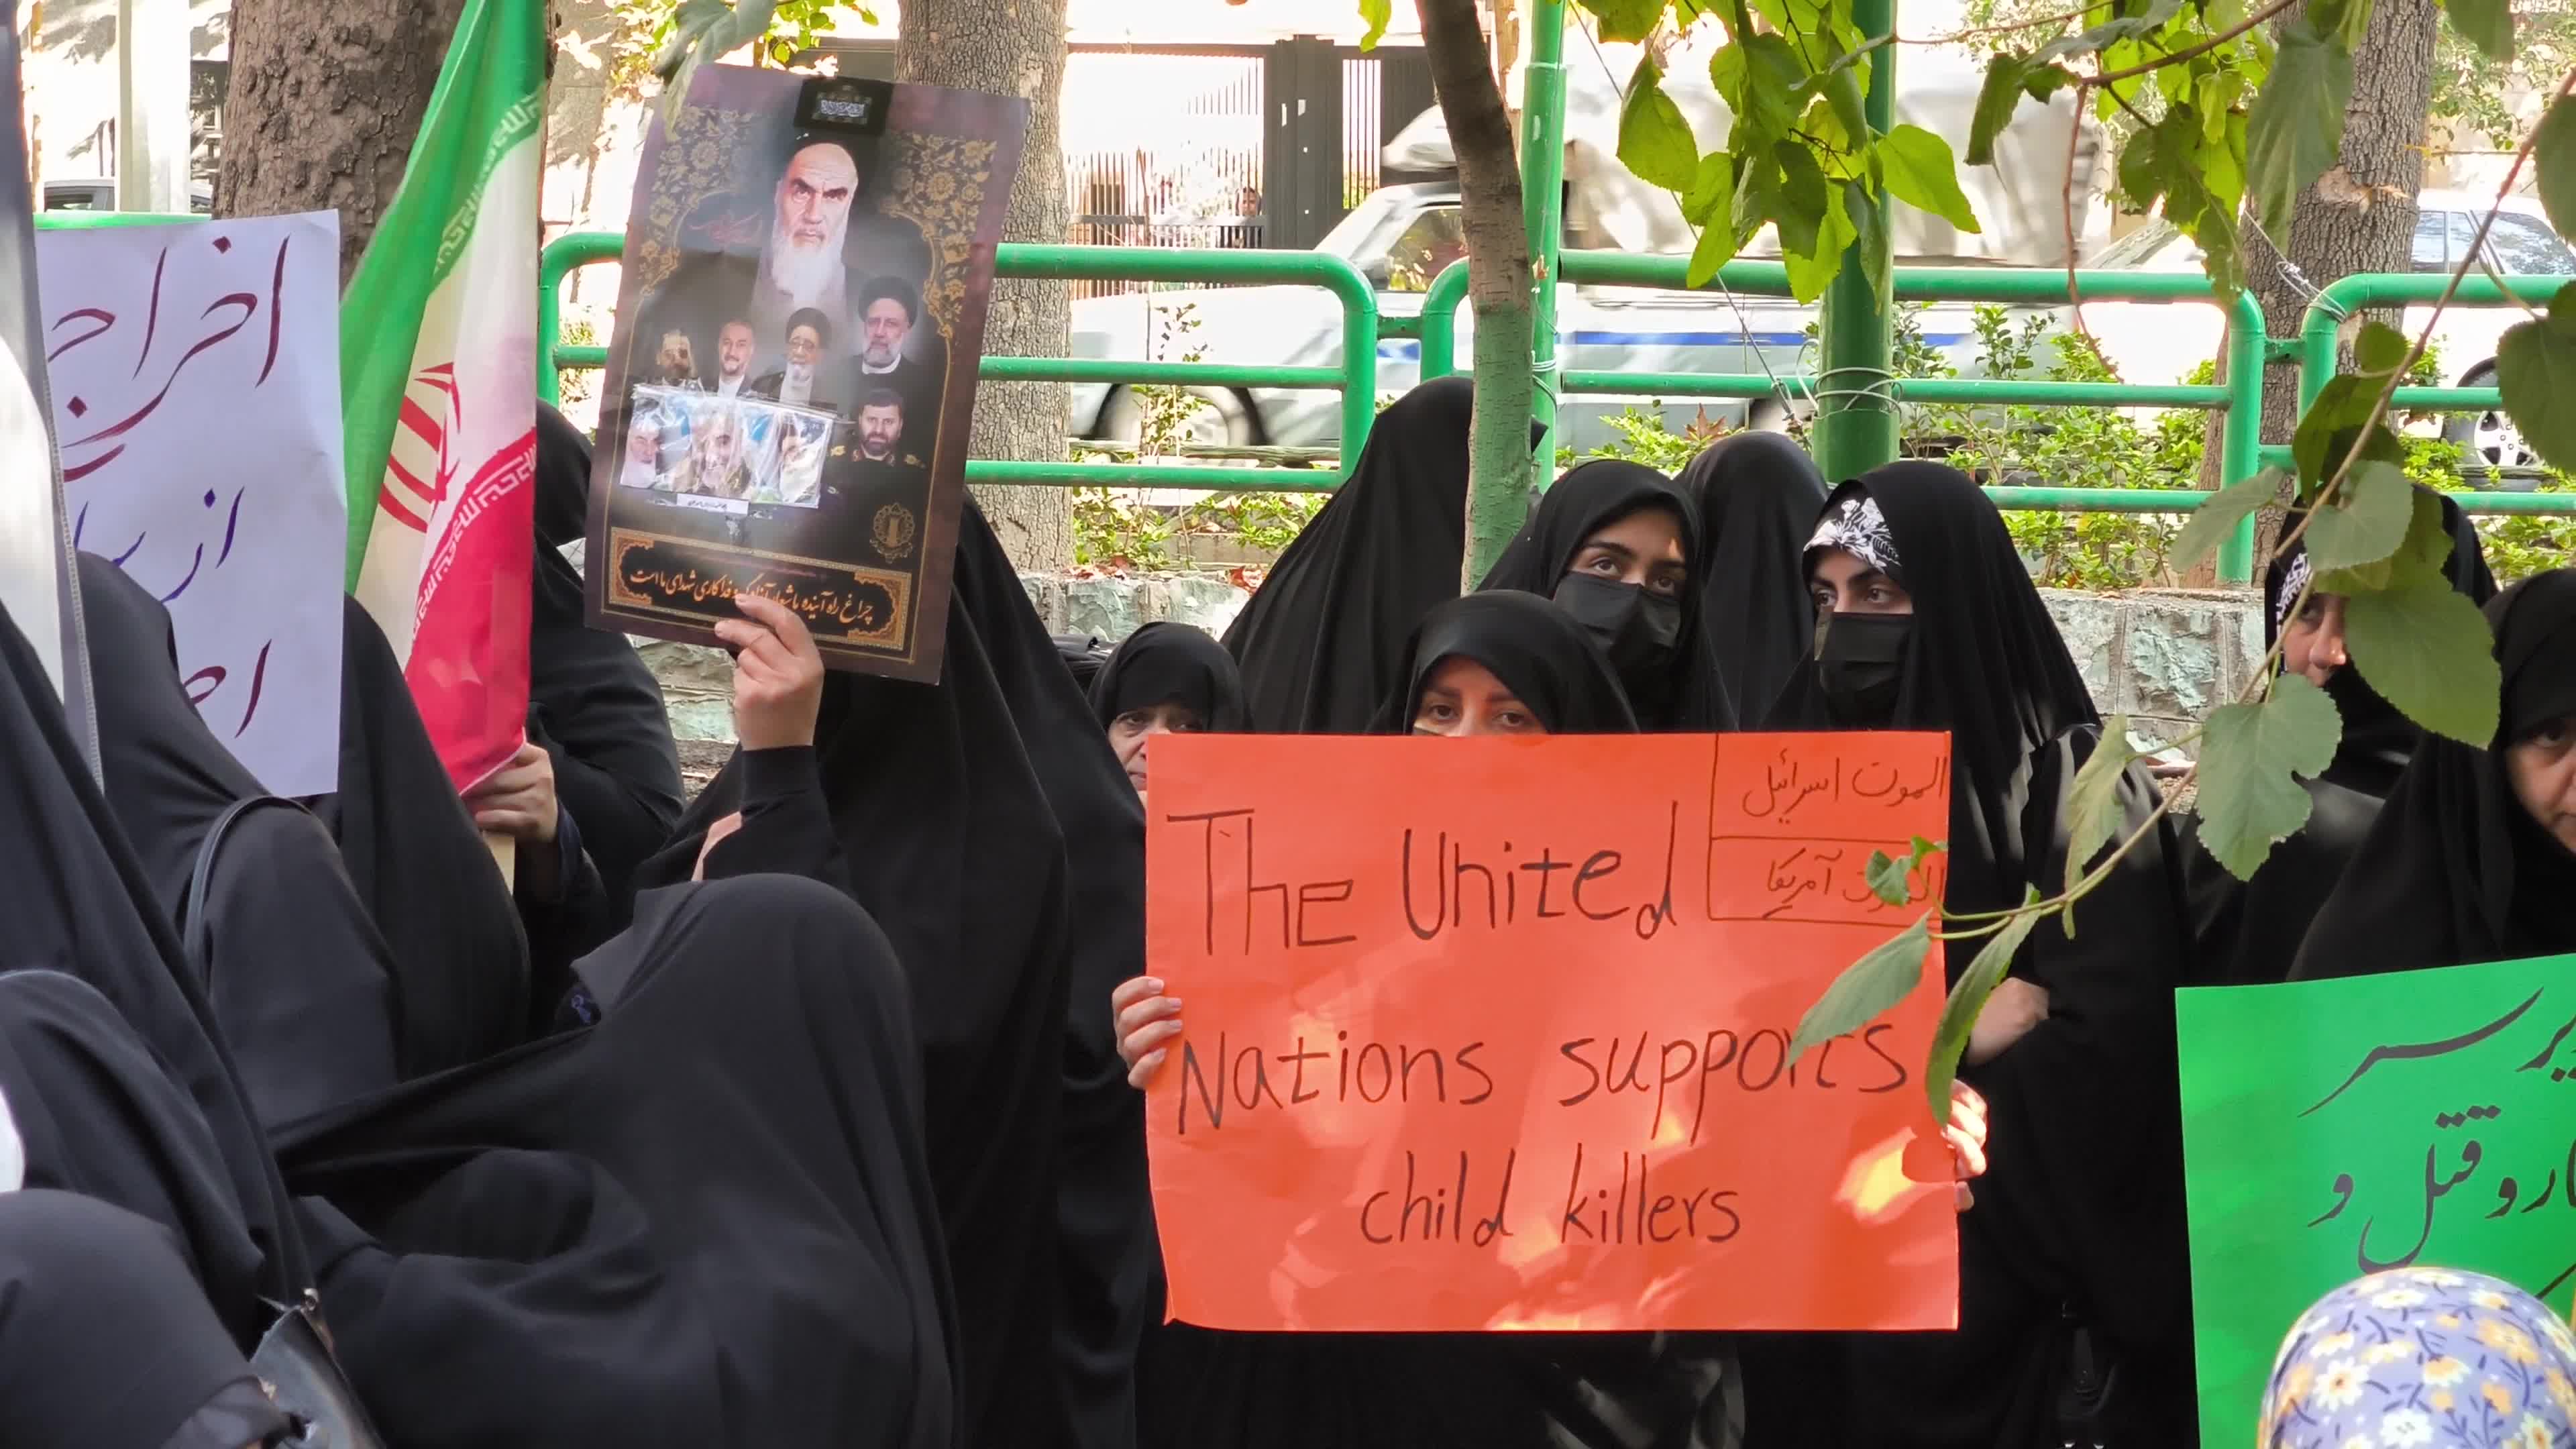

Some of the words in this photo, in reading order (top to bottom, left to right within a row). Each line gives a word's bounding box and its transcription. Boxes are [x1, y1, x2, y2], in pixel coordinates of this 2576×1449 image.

[1851, 756, 1947, 807] الموت
[1167, 808, 1356, 955] The
[1402, 800, 1678, 941] United
[1177, 1030, 1493, 1136] Nations
[1360, 1148, 1516, 1248] child
[1561, 1142, 1741, 1245] killers
